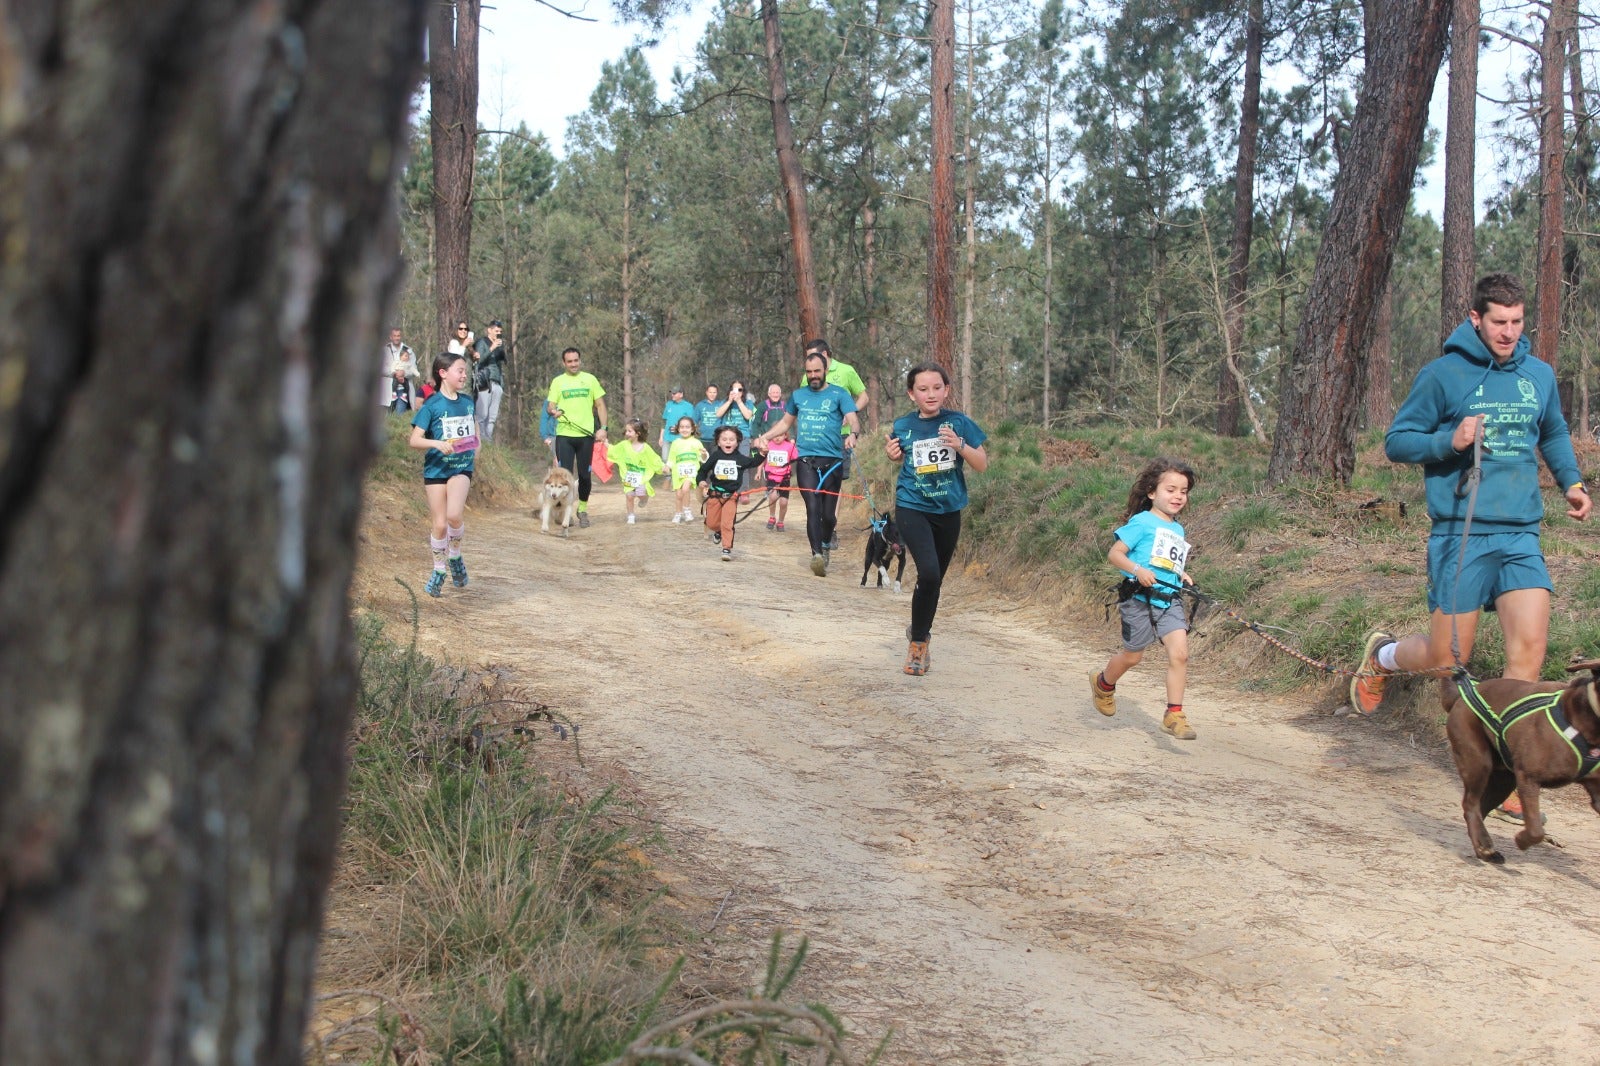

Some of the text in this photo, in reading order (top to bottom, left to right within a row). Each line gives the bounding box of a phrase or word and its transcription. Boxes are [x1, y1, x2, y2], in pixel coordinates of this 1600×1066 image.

[457, 425, 470, 436] 61
[928, 449, 949, 463] 62
[722, 467, 735, 475] 65
[1170, 546, 1184, 564] 64
